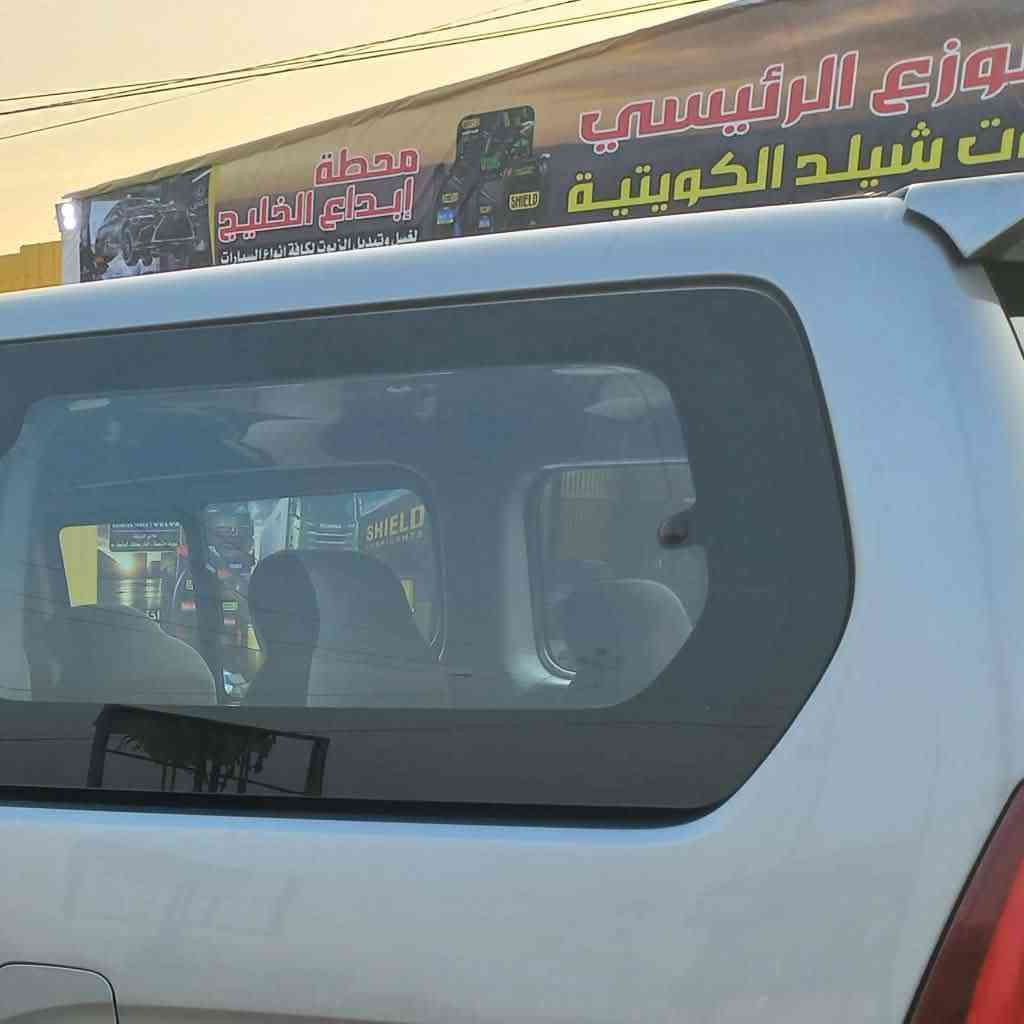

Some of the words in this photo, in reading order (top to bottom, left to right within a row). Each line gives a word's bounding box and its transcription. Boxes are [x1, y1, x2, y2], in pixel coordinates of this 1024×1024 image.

[580, 50, 860, 154] الرئيسي
[314, 147, 420, 187] محطة
[567, 144, 785, 216] الكويتية
[795, 121, 944, 188] شيلد
[218, 191, 314, 243] الخليج
[319, 177, 415, 231] إبداع
[366, 504, 425, 541] SHIELD
